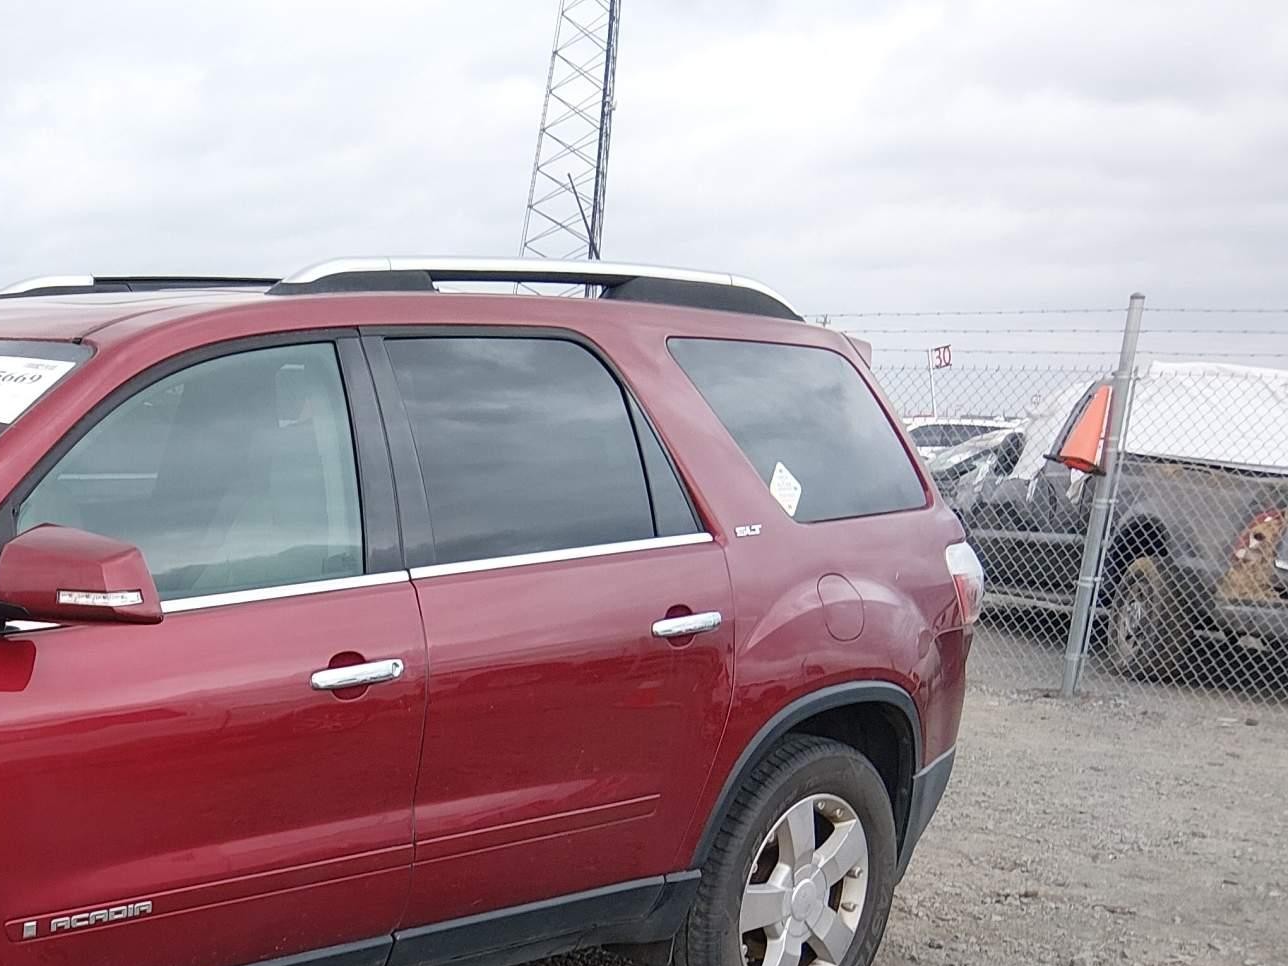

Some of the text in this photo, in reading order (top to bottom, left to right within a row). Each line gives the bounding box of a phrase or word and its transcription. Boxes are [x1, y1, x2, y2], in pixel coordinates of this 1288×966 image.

[933, 345, 952, 368] 30
[735, 524, 762, 537] SLT
[50, 900, 153, 933] ACADIA
